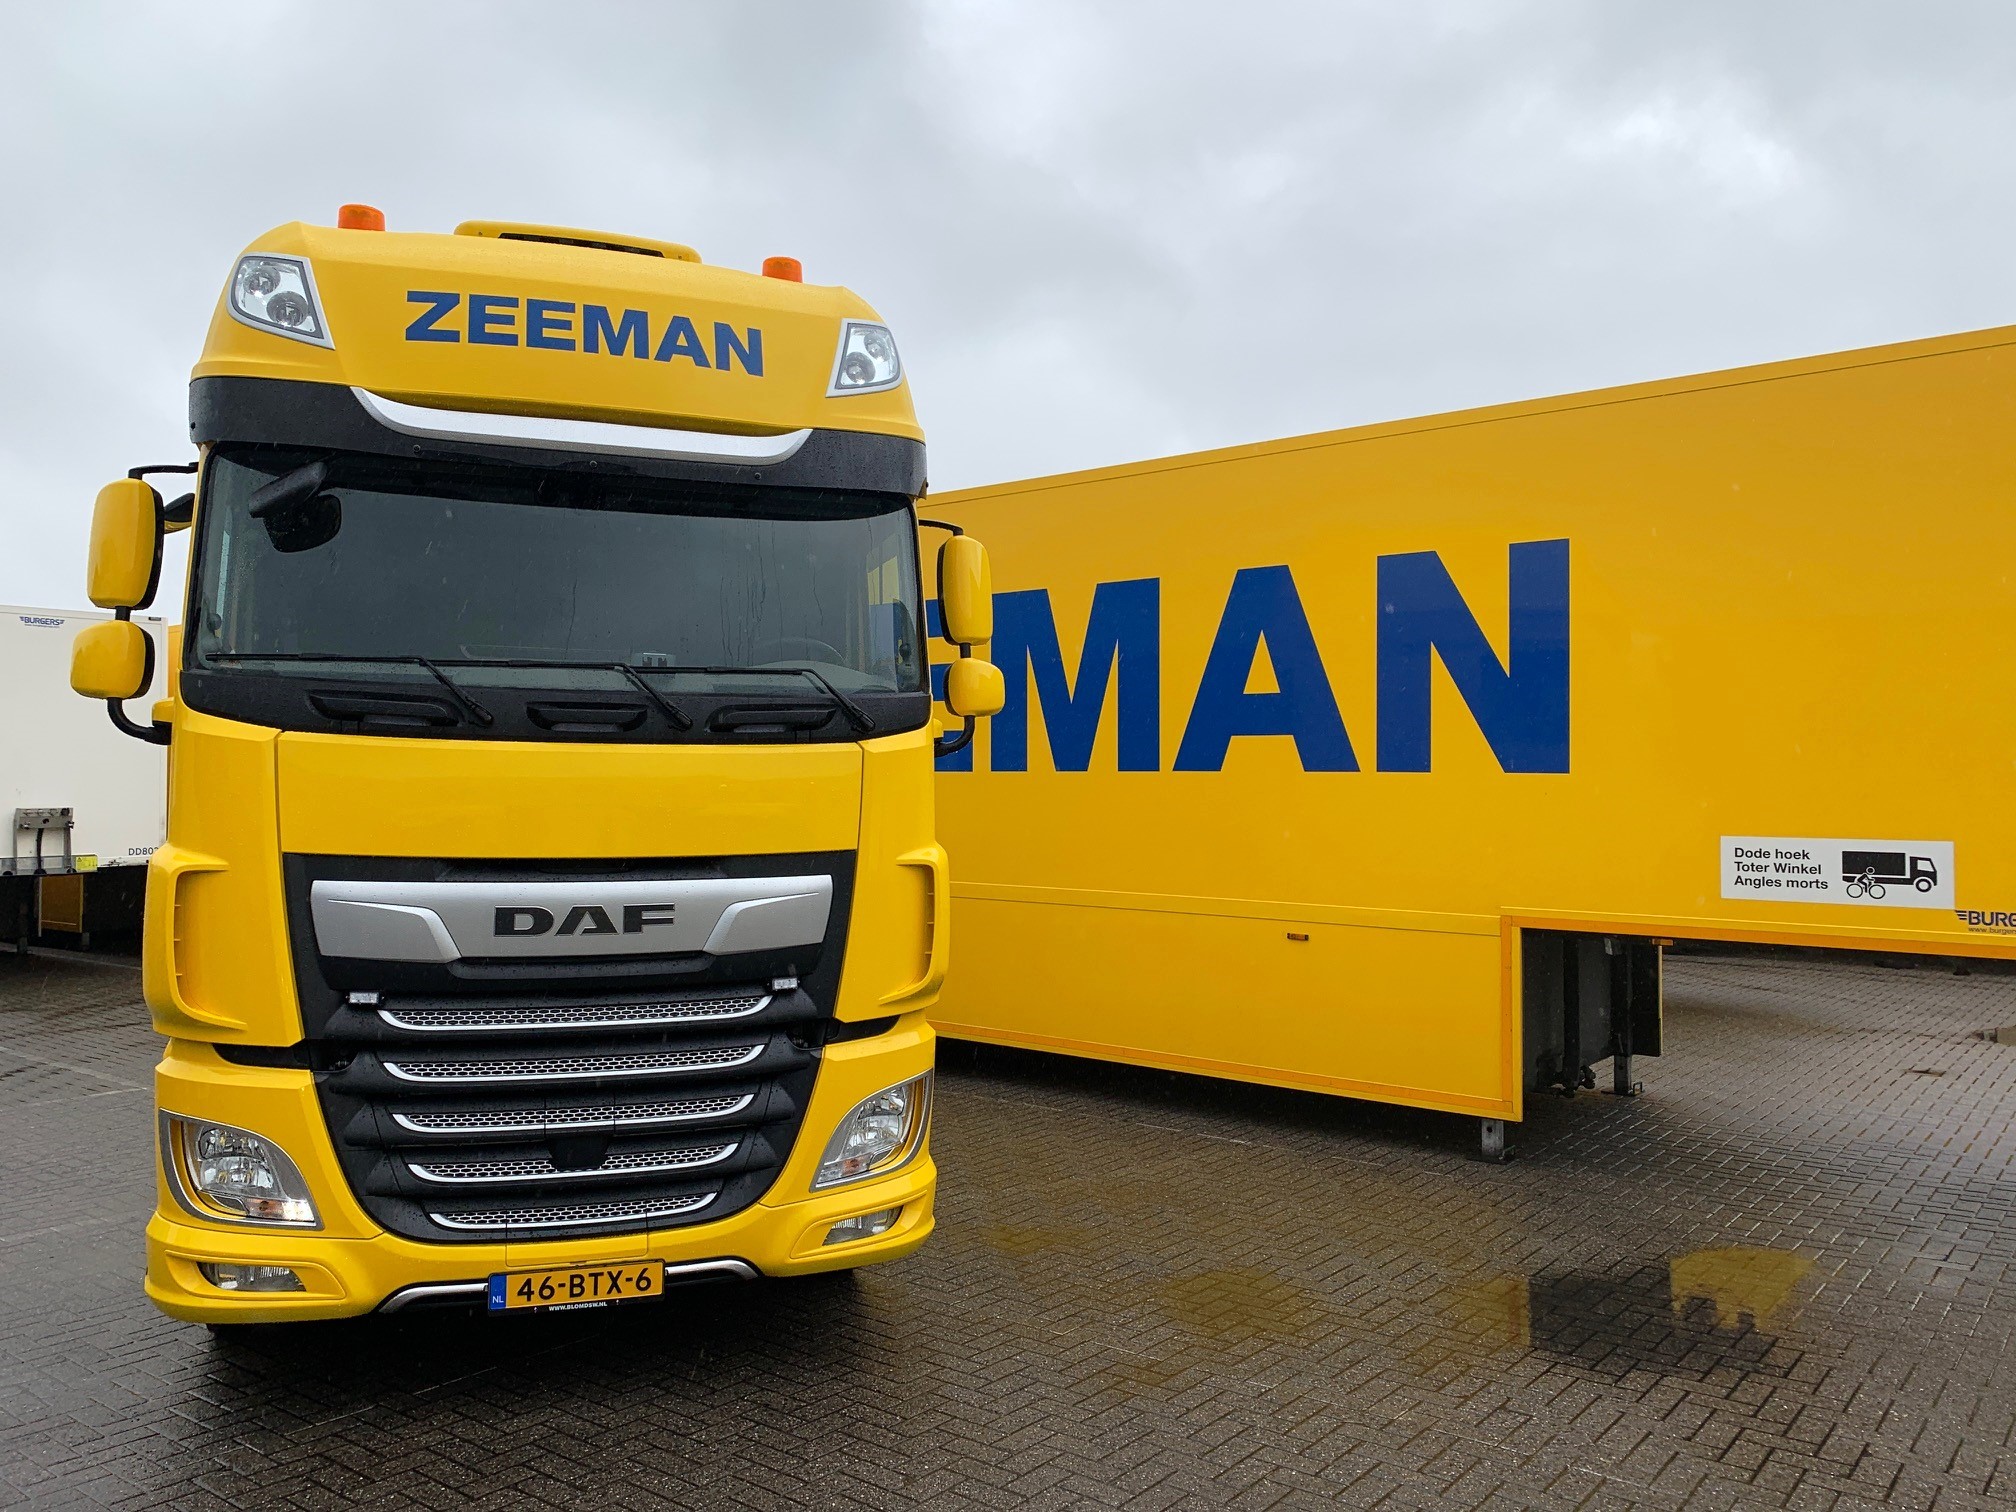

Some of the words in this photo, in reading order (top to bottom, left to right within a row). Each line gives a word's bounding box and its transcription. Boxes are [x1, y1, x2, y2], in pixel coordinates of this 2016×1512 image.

[405, 290, 764, 377] ZEEMAN
[24, 616, 61, 626] BURGERS
[925, 538, 1570, 774] MAN
[1734, 847, 1771, 859] Dode
[1775, 848, 1811, 860] hoek
[1734, 861, 1770, 873] Toter
[1773, 862, 1822, 875] Winkel
[1734, 875, 1782, 889] Angles
[1786, 879, 1829, 889] morts
[493, 902, 676, 938] DAF
[517, 1267, 652, 1302] 46-BTX-6
[492, 1294, 504, 1304] NL
